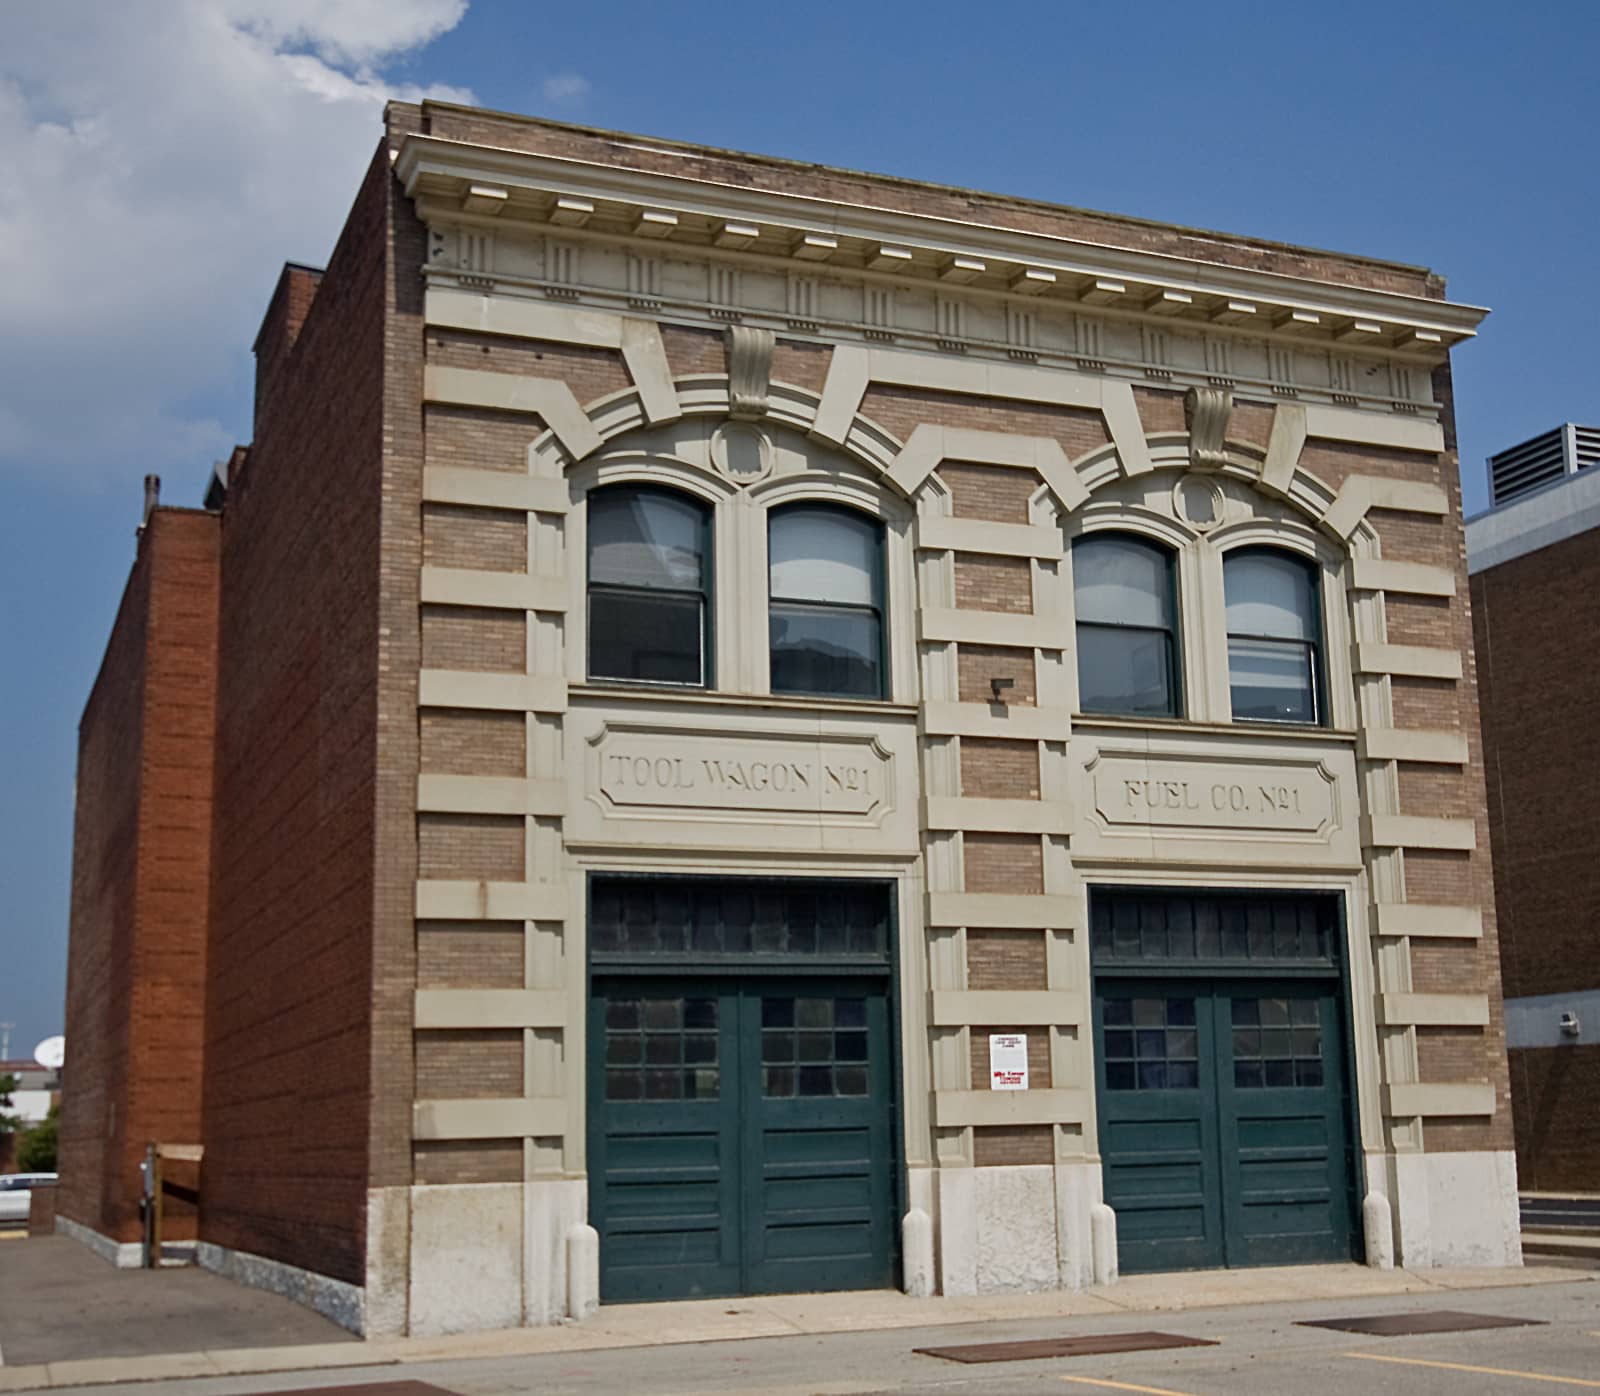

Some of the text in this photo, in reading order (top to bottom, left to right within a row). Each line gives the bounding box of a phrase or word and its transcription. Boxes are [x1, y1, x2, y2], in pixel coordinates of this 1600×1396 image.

[608, 755, 695, 788] TOOL
[700, 760, 812, 792] WAGON
[1123, 780, 1200, 810] FUEL
[1210, 784, 1250, 812] CO.
